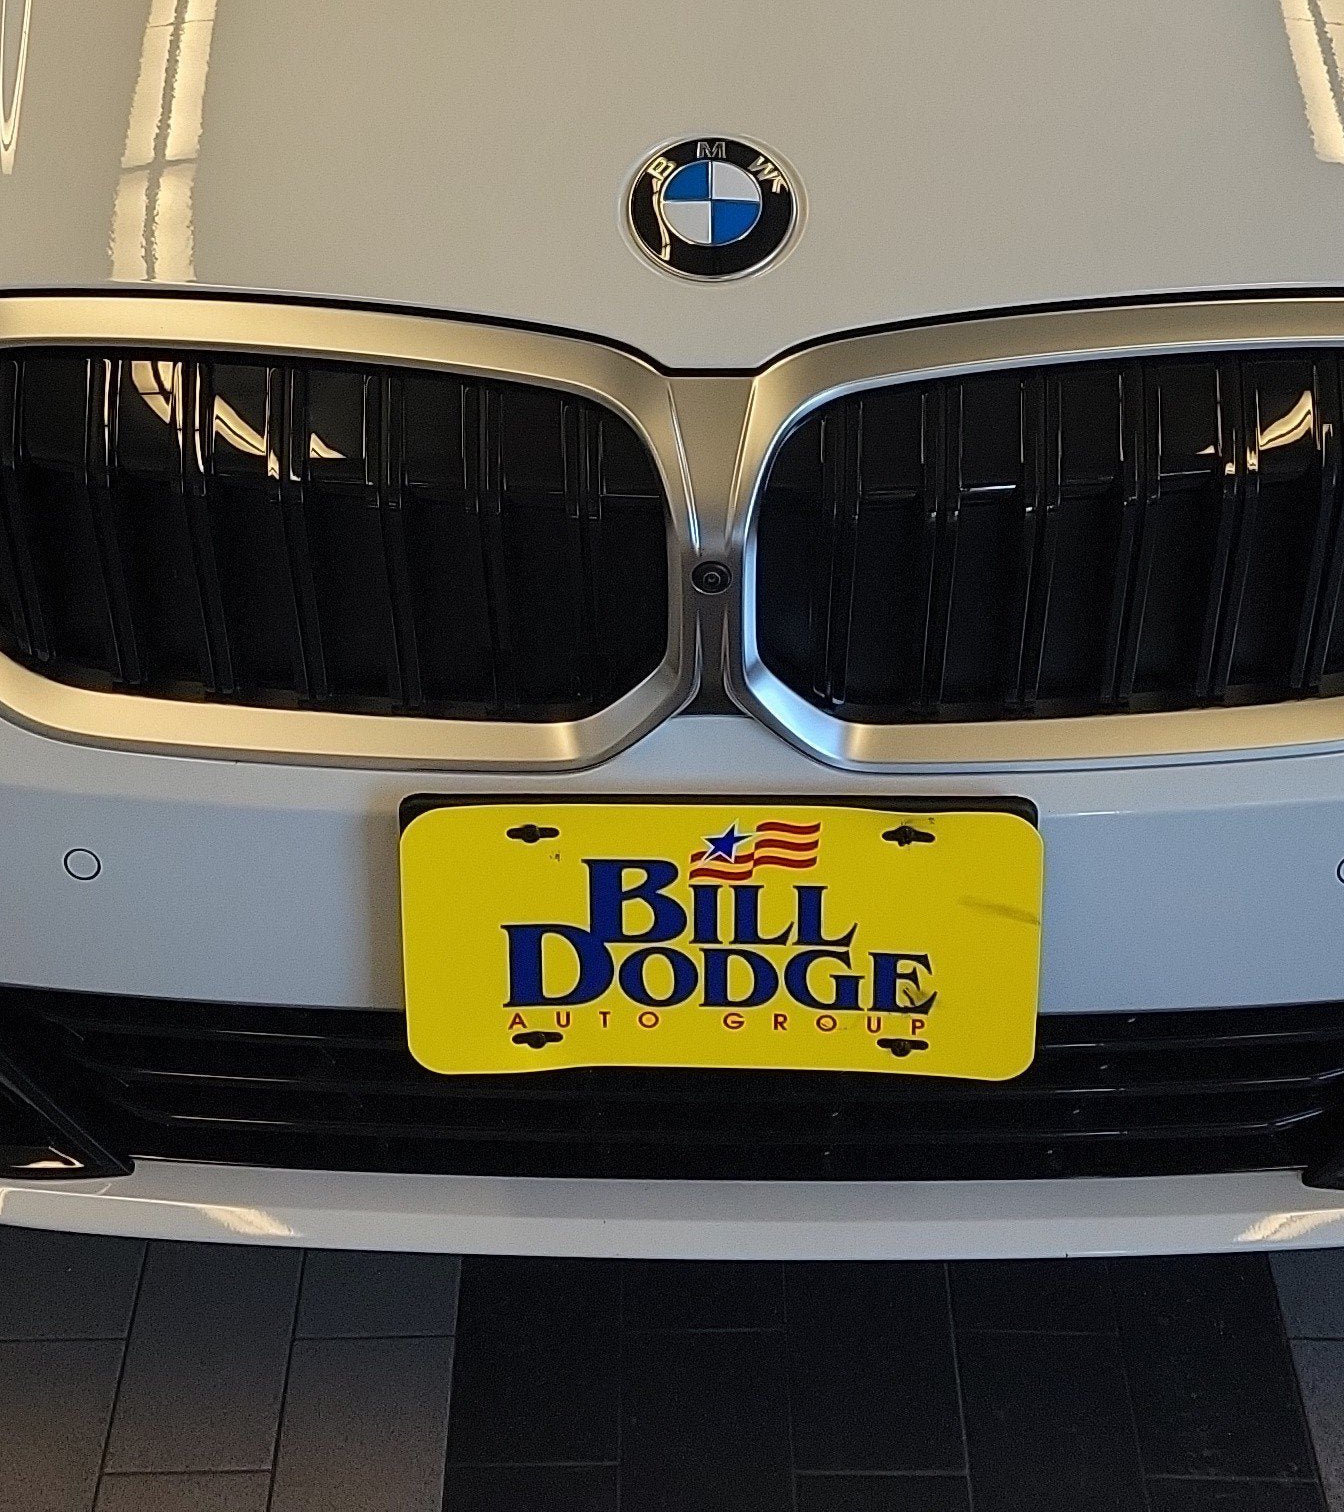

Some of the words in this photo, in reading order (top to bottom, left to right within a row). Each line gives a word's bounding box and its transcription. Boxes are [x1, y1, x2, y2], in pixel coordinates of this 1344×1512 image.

[646, 141, 786, 193] BMW
[508, 1010, 661, 1031] AUTO
[723, 1011, 927, 1036] GROUP
